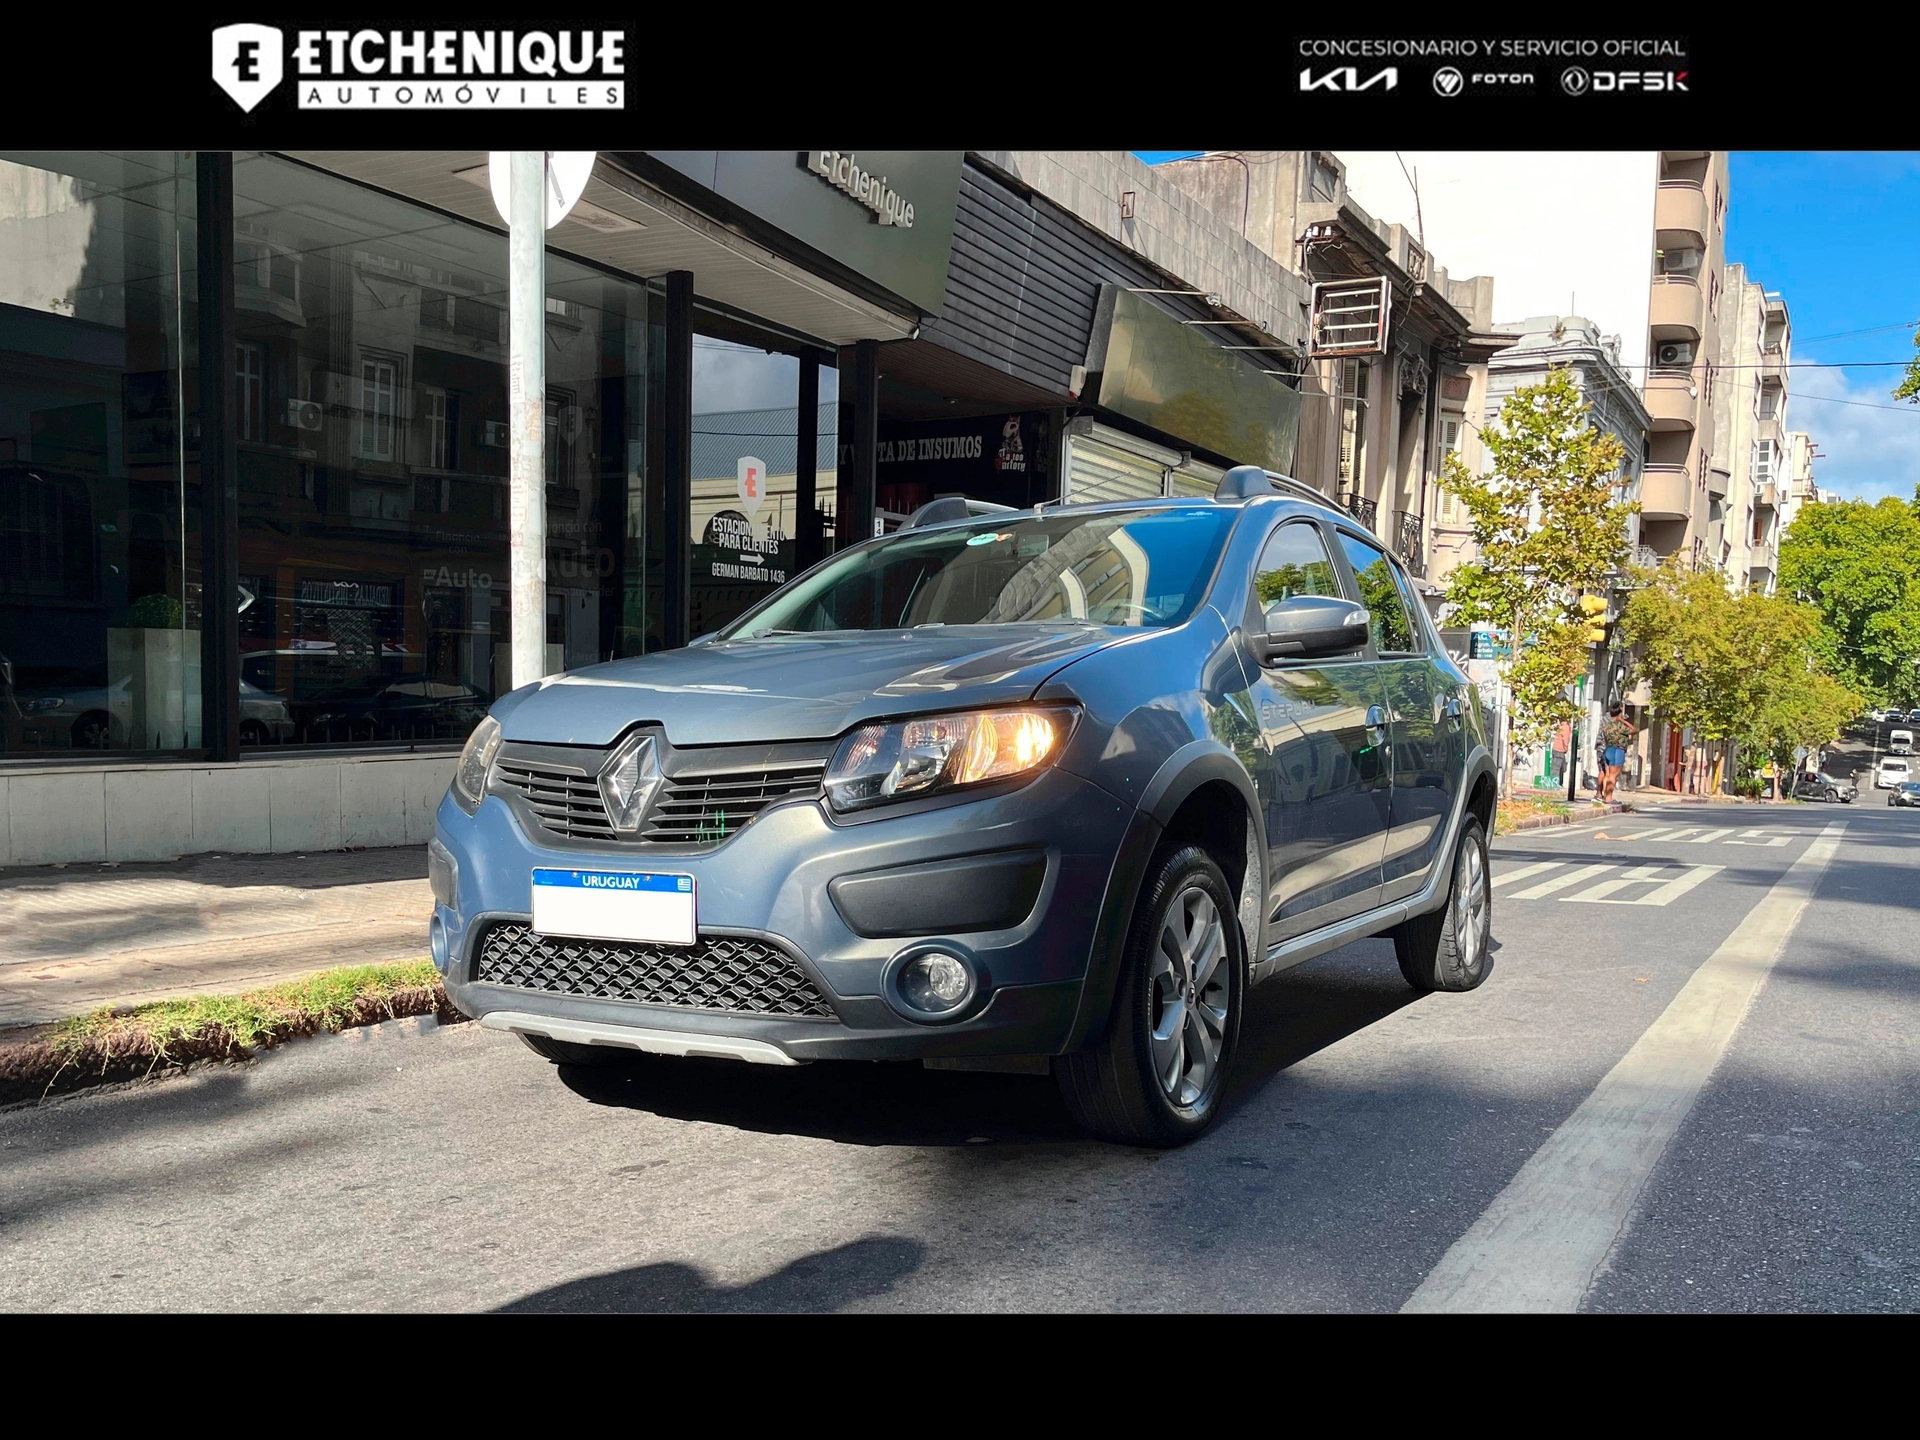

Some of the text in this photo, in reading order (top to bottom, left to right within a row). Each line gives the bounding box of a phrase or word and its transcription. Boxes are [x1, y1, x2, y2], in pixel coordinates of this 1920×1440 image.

[897, 440, 916, 462] DE
[918, 435, 983, 461] INSUMOS
[712, 517, 785, 541] ESTACIONENTO
[719, 533, 779, 555] PARA CLIENTES
[712, 562, 786, 584] GERMAN BARBATO 1436
[582, 875, 640, 889] URUGUAY
